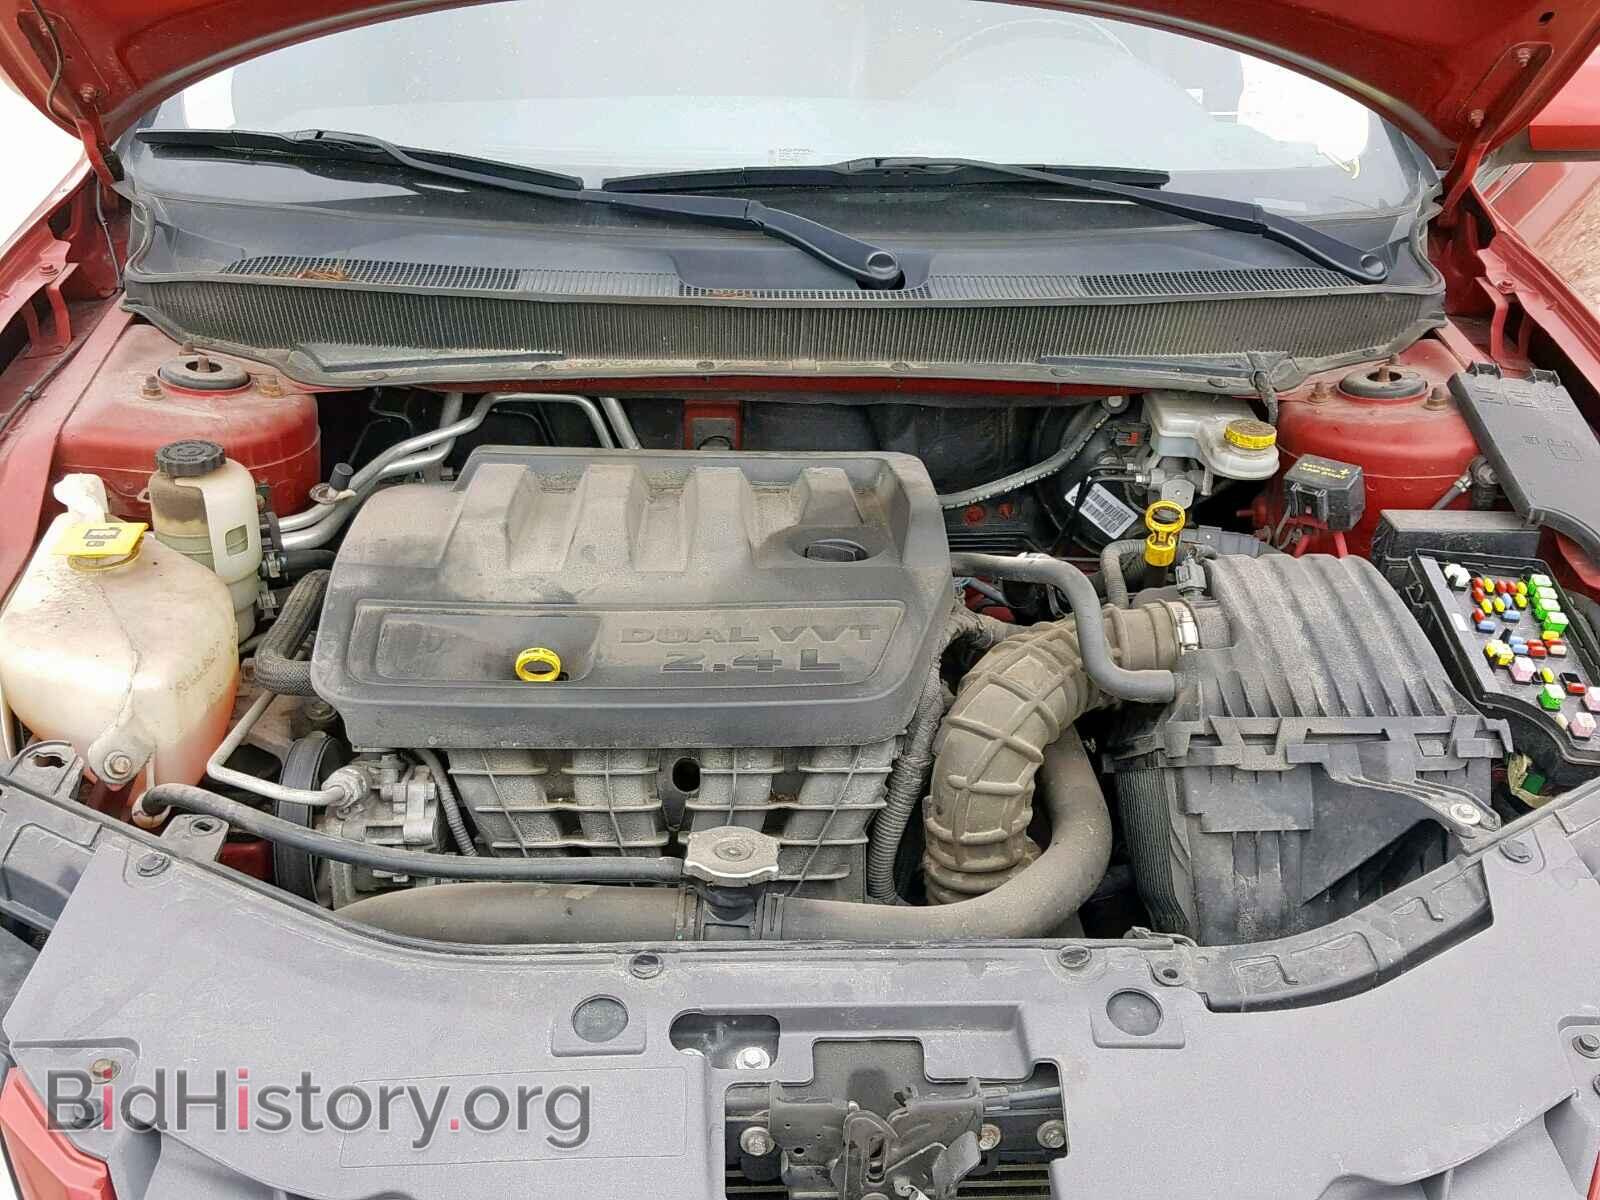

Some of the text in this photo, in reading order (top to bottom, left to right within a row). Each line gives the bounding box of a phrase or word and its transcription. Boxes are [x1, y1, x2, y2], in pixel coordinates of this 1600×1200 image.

[620, 624, 880, 643] DUAL VVT
[662, 649, 841, 672] 2.4L
